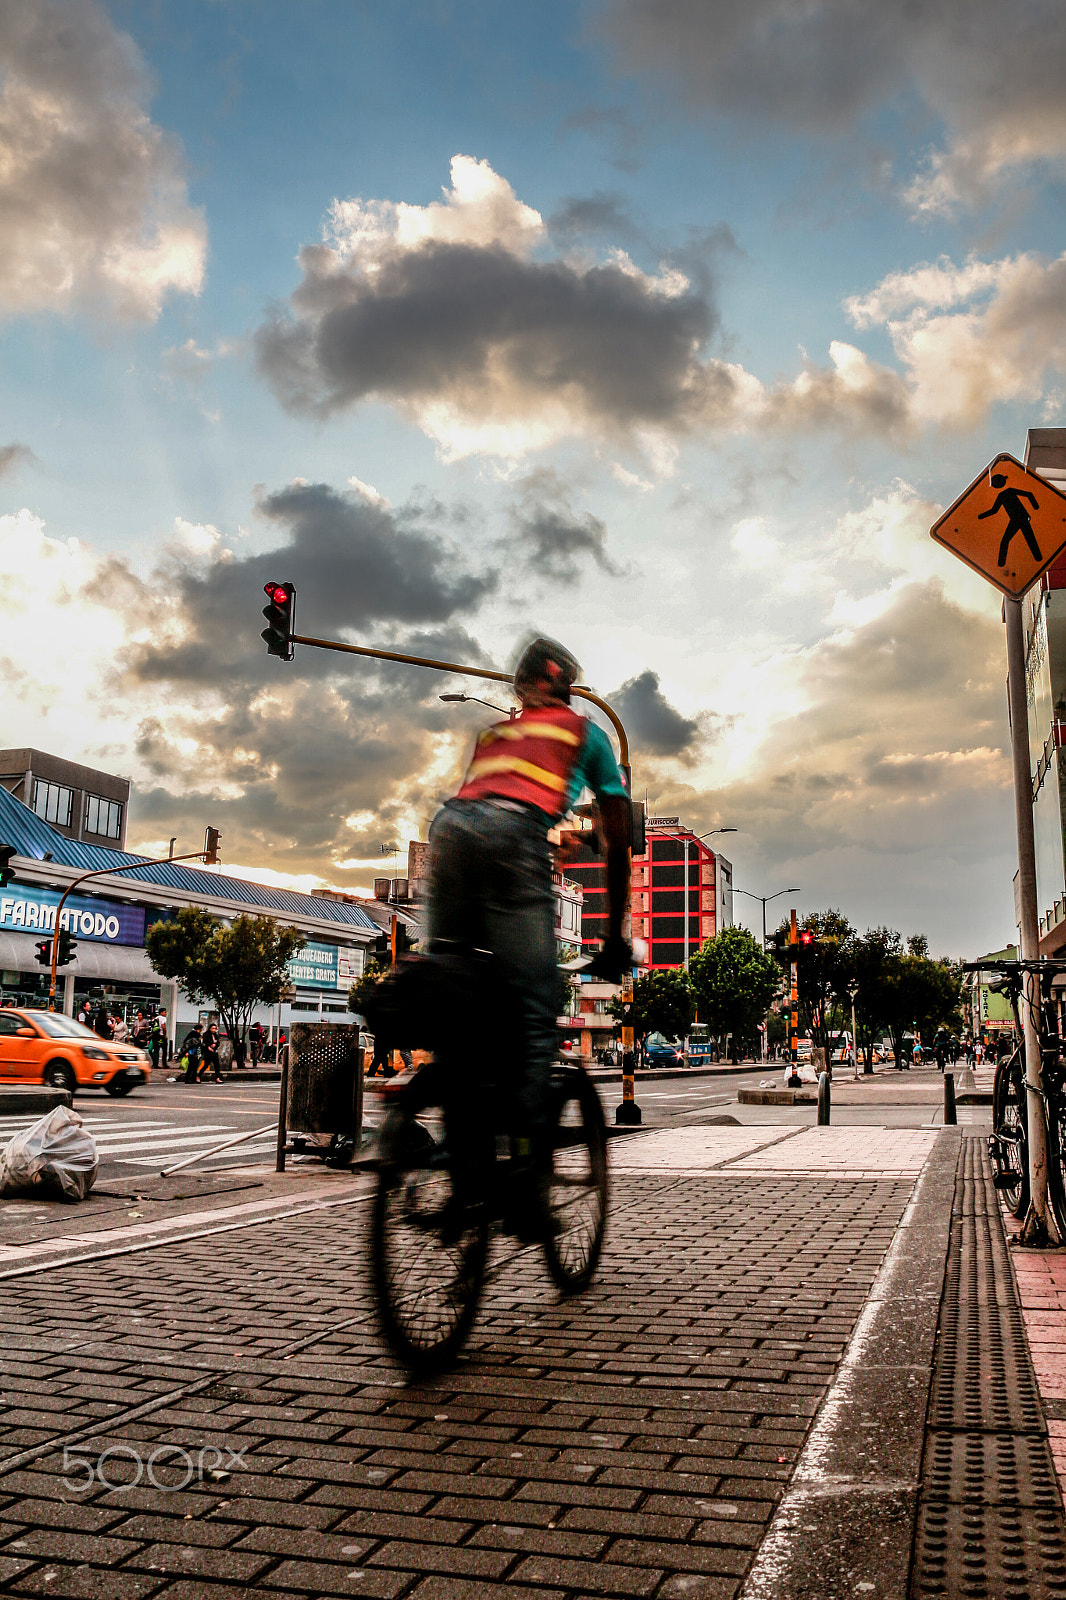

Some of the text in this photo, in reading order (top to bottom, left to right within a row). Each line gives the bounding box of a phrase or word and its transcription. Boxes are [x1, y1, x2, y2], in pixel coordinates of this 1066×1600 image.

[0, 897, 120, 939] FARMATODO
[292, 948, 333, 964] RQUEADERO
[315, 968, 336, 982] GRATIS
